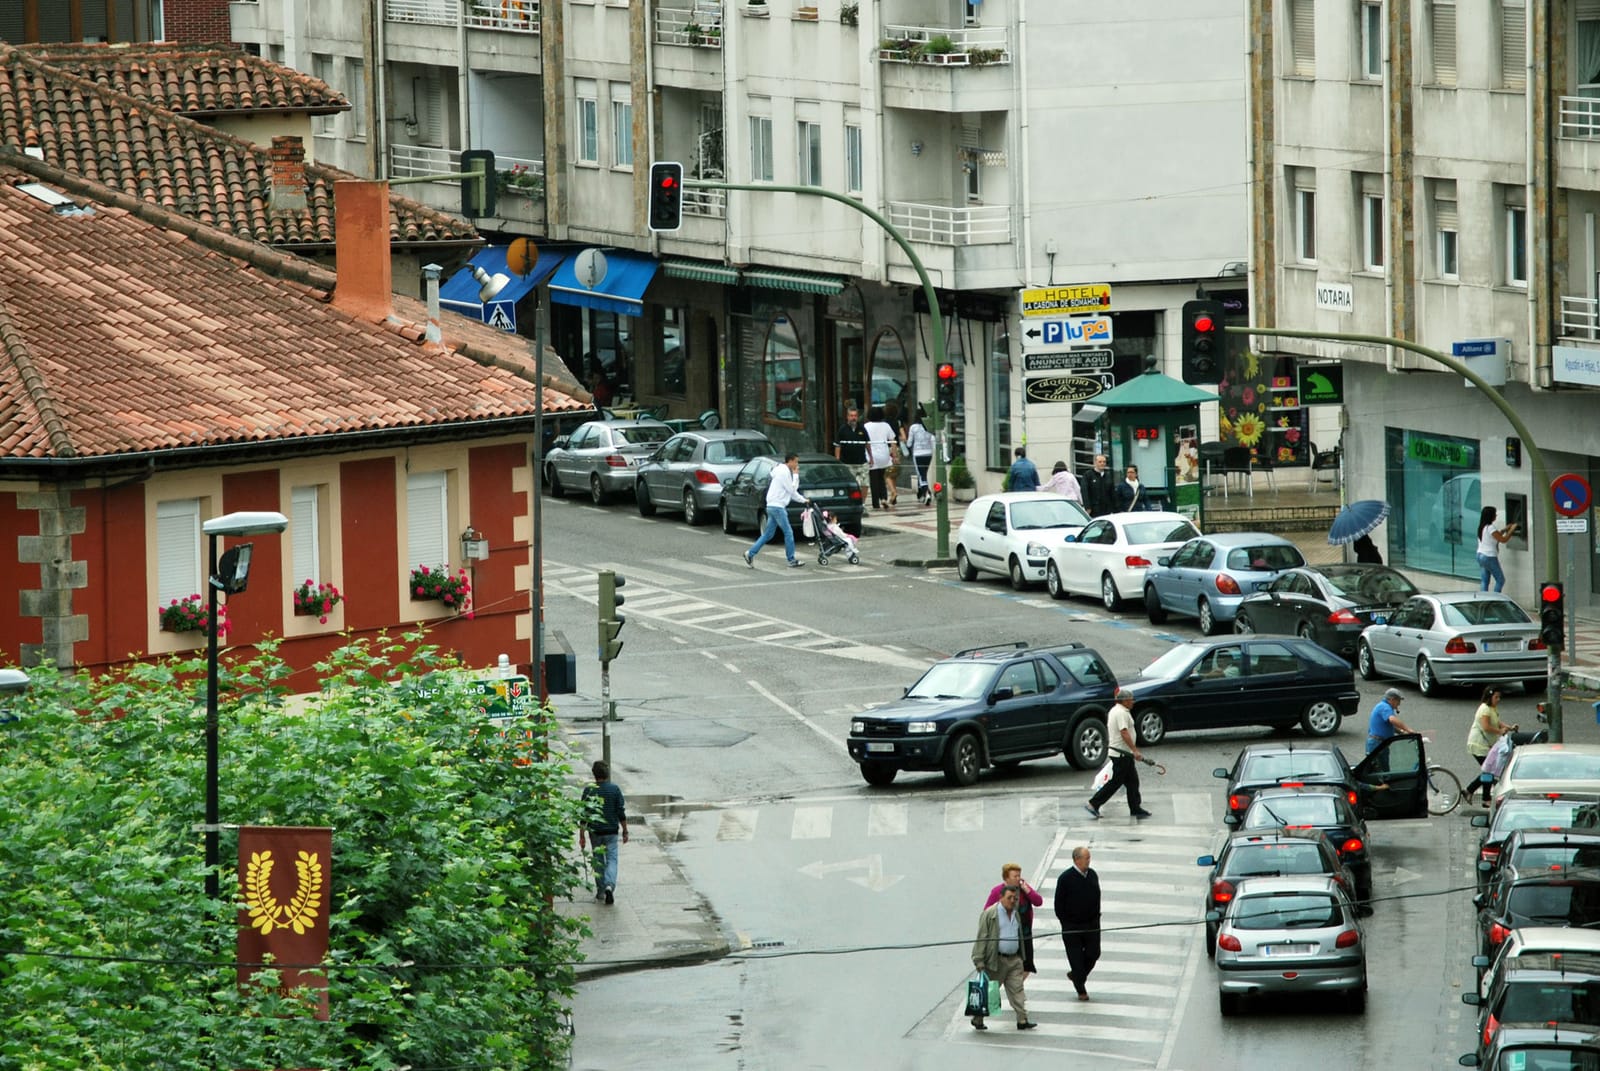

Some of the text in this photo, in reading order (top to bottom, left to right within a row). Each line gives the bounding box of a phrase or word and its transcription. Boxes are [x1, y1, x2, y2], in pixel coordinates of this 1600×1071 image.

[1045, 287, 1100, 300] HOTEL
[1318, 288, 1351, 306] NOTARIA
[1024, 302, 1032, 310] LA
[1033, 301, 1058, 309] CASONA
[1048, 324, 1059, 341] P
[1065, 320, 1109, 342] lupa
